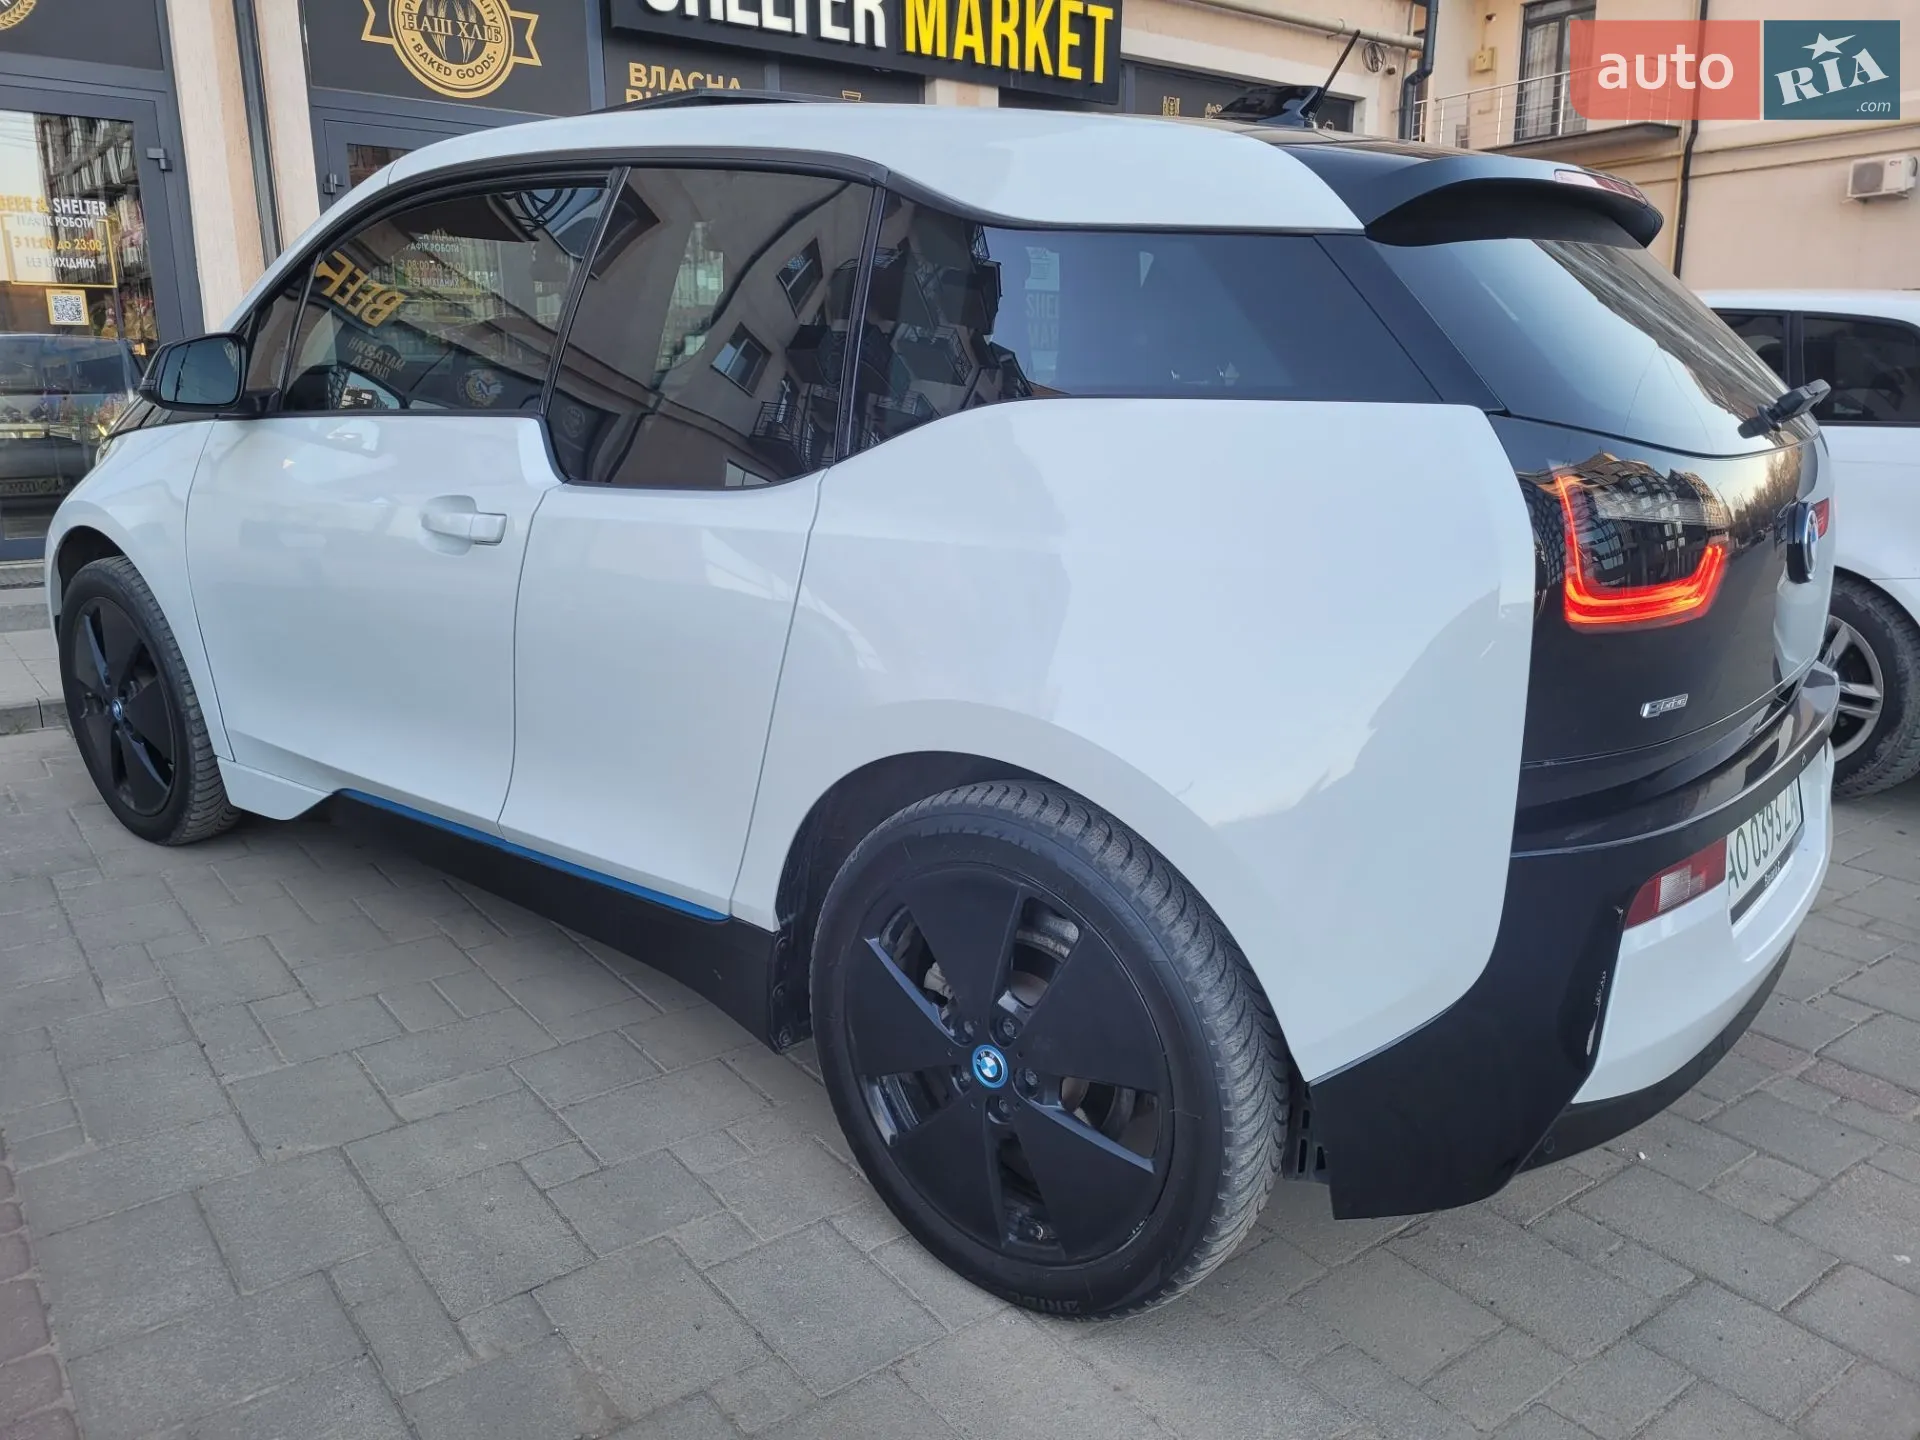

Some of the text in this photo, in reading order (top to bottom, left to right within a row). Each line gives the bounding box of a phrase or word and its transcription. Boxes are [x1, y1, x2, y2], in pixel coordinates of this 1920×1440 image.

[402, 12, 453, 36] НАШ
[906, 0, 1114, 84] MARKET
[413, 43, 495, 79] BAKED GOODS
[53, 198, 107, 216] SHELTER
[55, 217, 94, 228] РОБОТИ
[73, 239, 102, 251] 23:00
[1750, 798, 1782, 868] 0393
